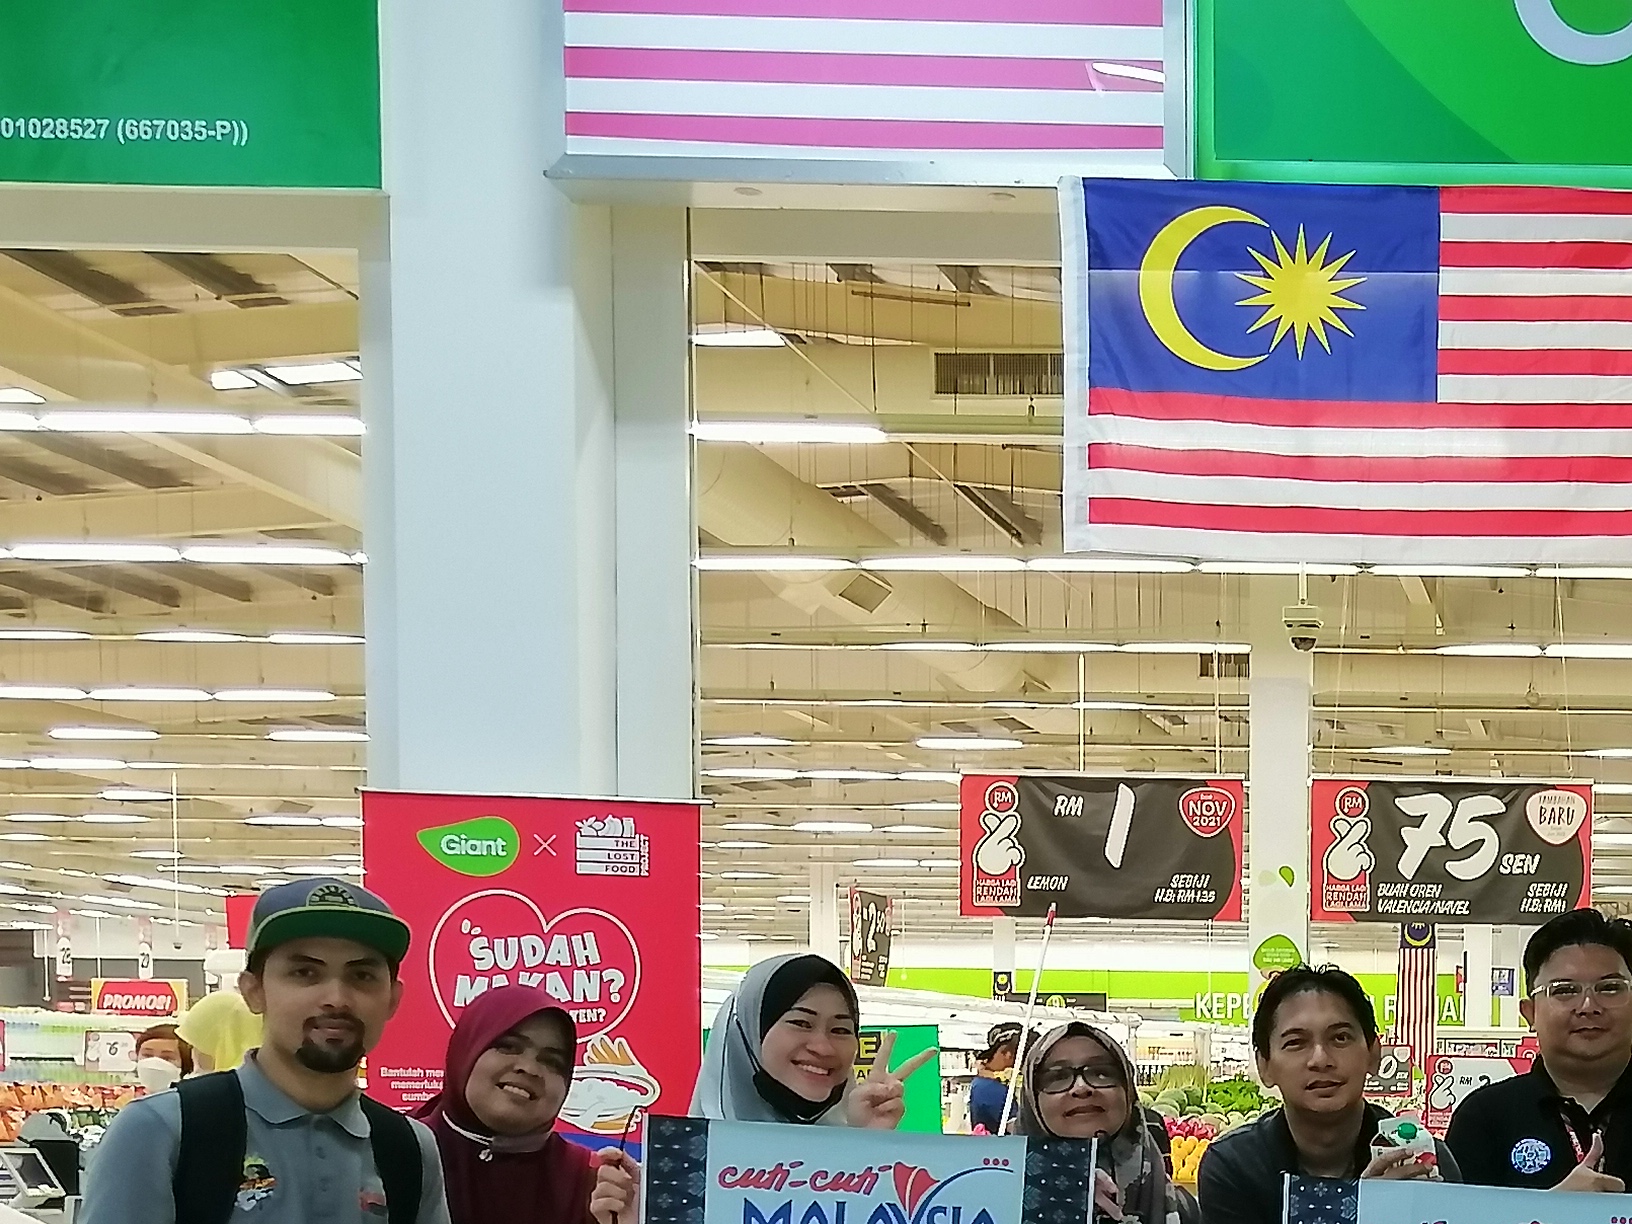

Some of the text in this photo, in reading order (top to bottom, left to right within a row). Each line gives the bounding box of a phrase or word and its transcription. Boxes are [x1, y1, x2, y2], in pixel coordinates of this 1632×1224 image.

[0, 118, 249, 147] 01028527 (667035-P))
[1188, 800, 1228, 817] NOV
[1539, 805, 1576, 826] BARU
[1053, 782, 1137, 869] RM 1
[1192, 816, 1222, 827] 2021
[613, 839, 636, 848] THE
[1395, 791, 1542, 881] 75 SEN
[440, 833, 508, 858] Giant
[606, 852, 635, 861] LOST
[604, 864, 636, 873] FOOD
[1026, 875, 1069, 891] LEMON
[1169, 873, 1211, 889] SEBIJI
[1326, 892, 1367, 902] RENDAH
[1377, 882, 1443, 899] BUAH OREN
[1526, 882, 1569, 898] SEBIJI
[1377, 898, 1470, 915] VALENCIA/NAVEL
[468, 931, 602, 972] SUDAH
[102, 993, 172, 1011] PROMOSI
